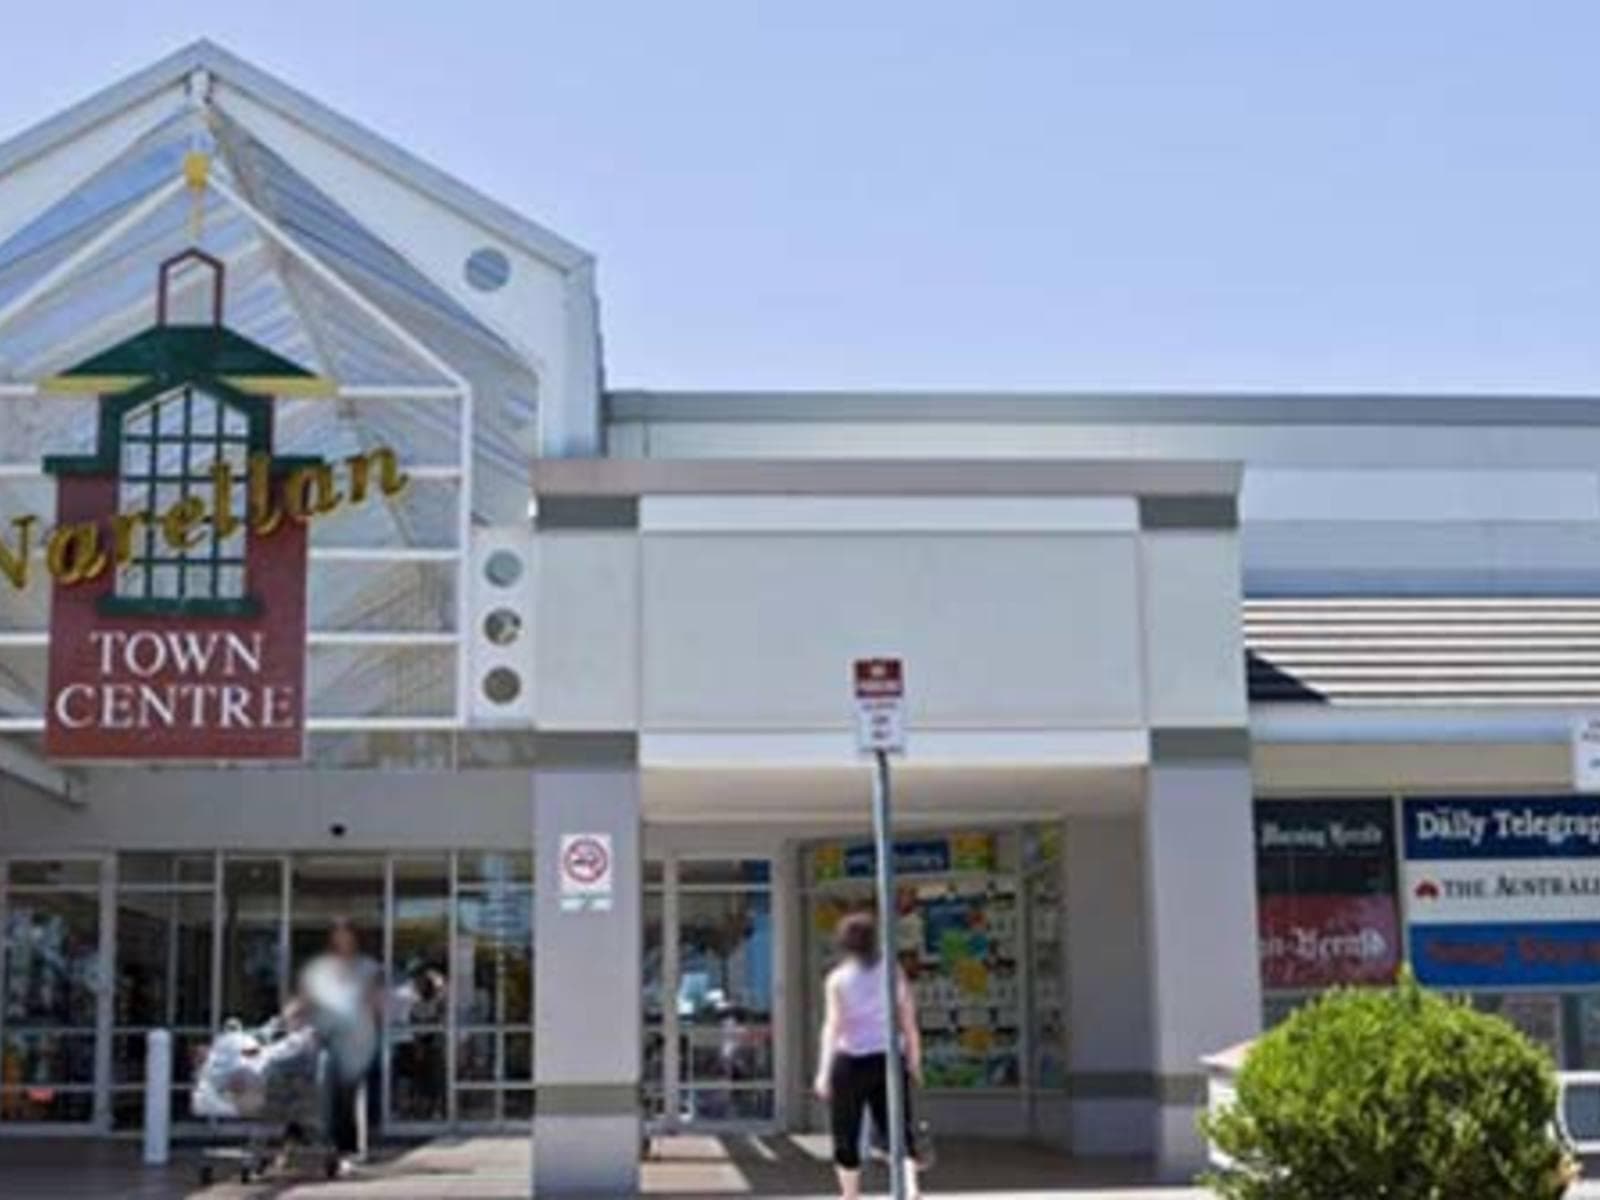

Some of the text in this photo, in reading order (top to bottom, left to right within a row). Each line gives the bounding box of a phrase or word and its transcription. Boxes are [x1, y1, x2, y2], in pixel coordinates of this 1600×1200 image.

[0, 447, 409, 591] Narellan
[90, 631, 266, 676] TOWN
[55, 683, 295, 729] CENTRE
[1416, 807, 1485, 846] Daily
[1444, 878, 1487, 897] THE
